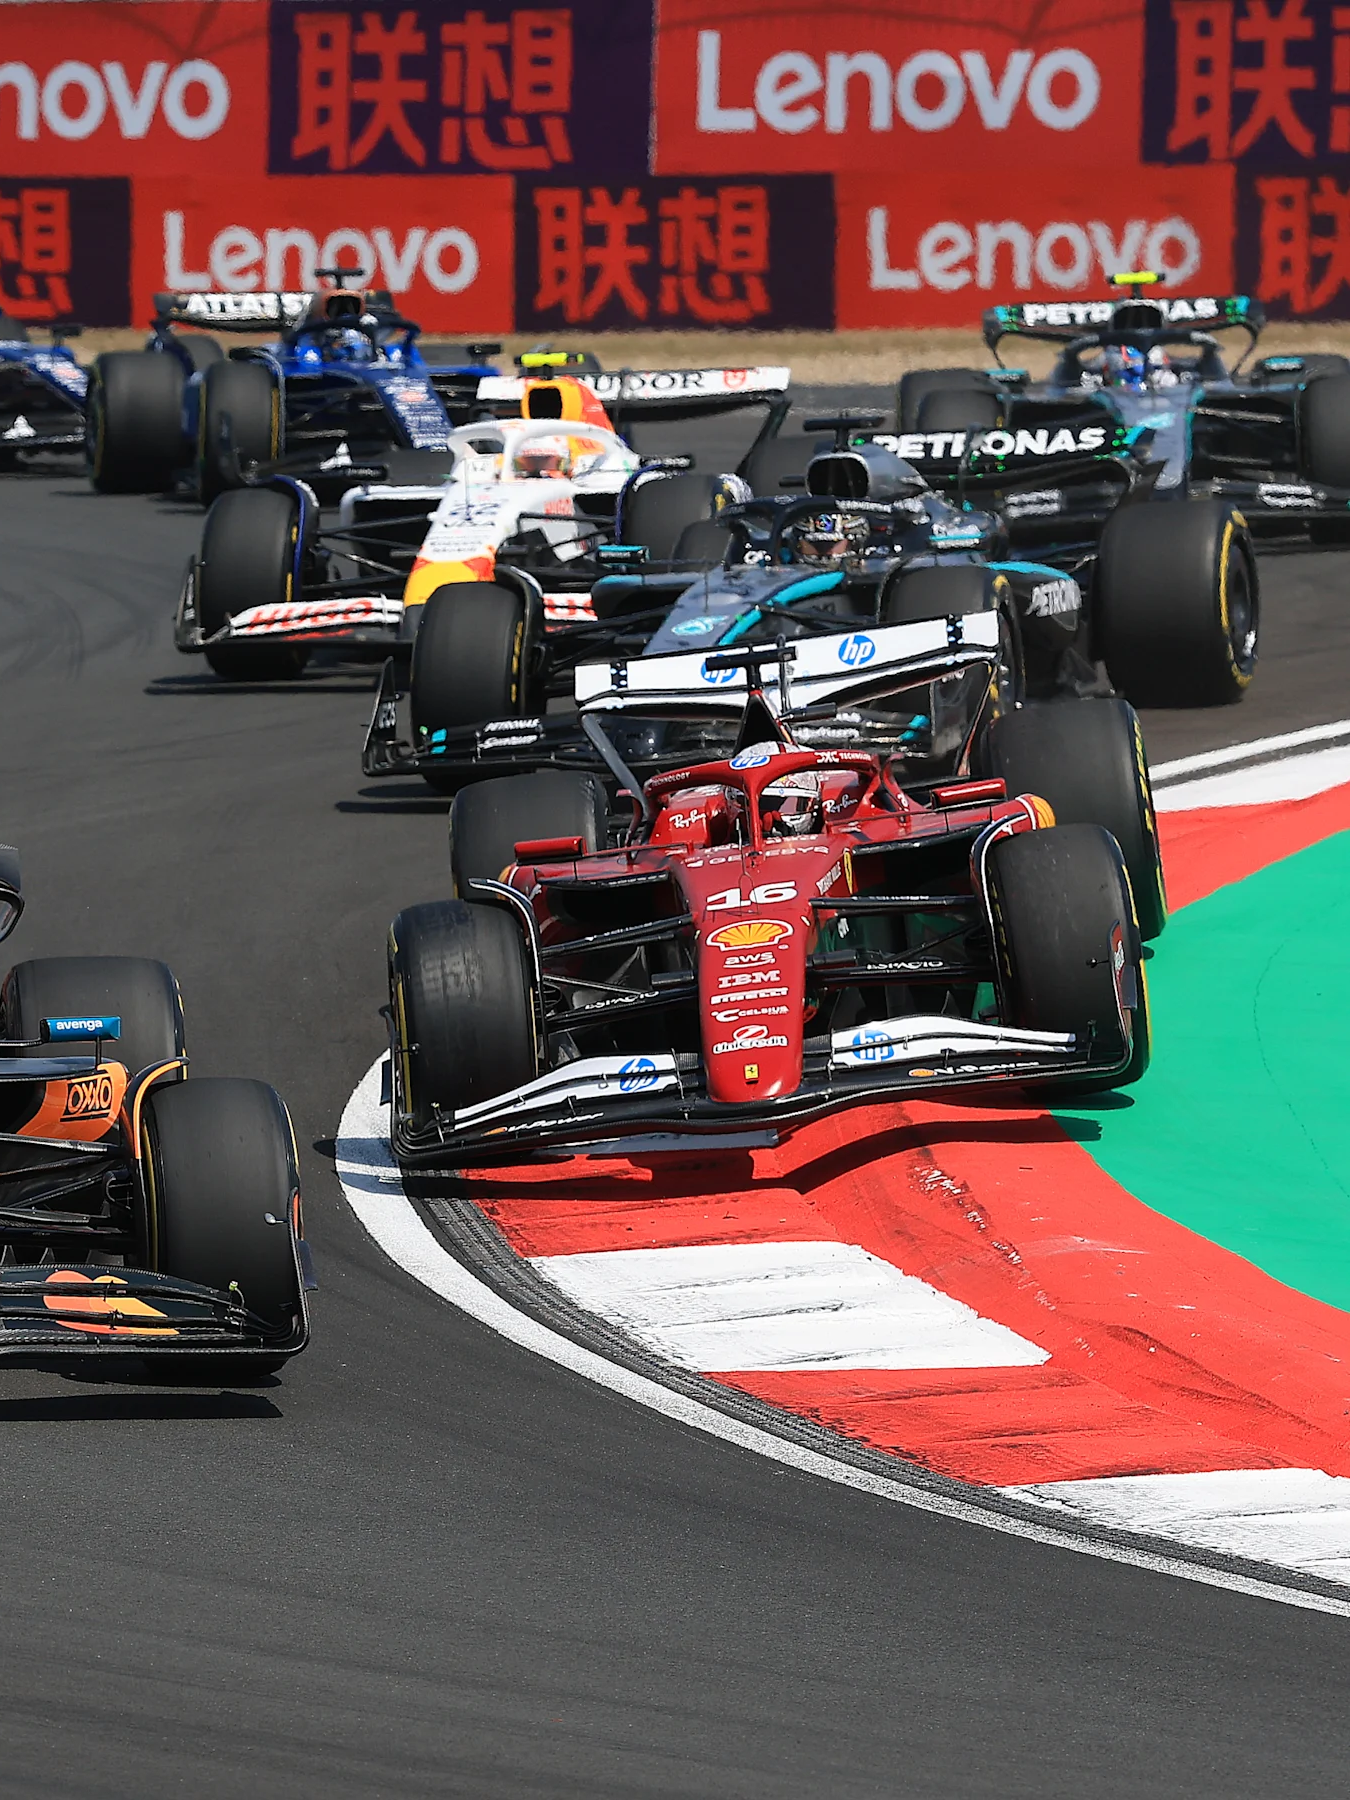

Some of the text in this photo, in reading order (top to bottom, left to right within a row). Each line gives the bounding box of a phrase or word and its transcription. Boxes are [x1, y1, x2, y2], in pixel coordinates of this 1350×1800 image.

[291, 9, 573, 171] 联想
[696, 29, 1100, 133] Lenovo
[1166, 0, 1350, 160] 联
[163, 210, 479, 294] Lenovo
[533, 186, 770, 322] 联想
[866, 207, 1201, 290] Lenovo
[585, 370, 704, 391] UDOR
[841, 634, 874, 665] hp
[706, 880, 799, 911] 16
[724, 951, 775, 968] aws
[717, 969, 781, 989] IBM
[710, 986, 789, 1005] PIRELLI
[56, 1018, 104, 1032] avenga
[712, 1035, 789, 1055] UniCredit
[67, 1078, 113, 1114] OXXO
